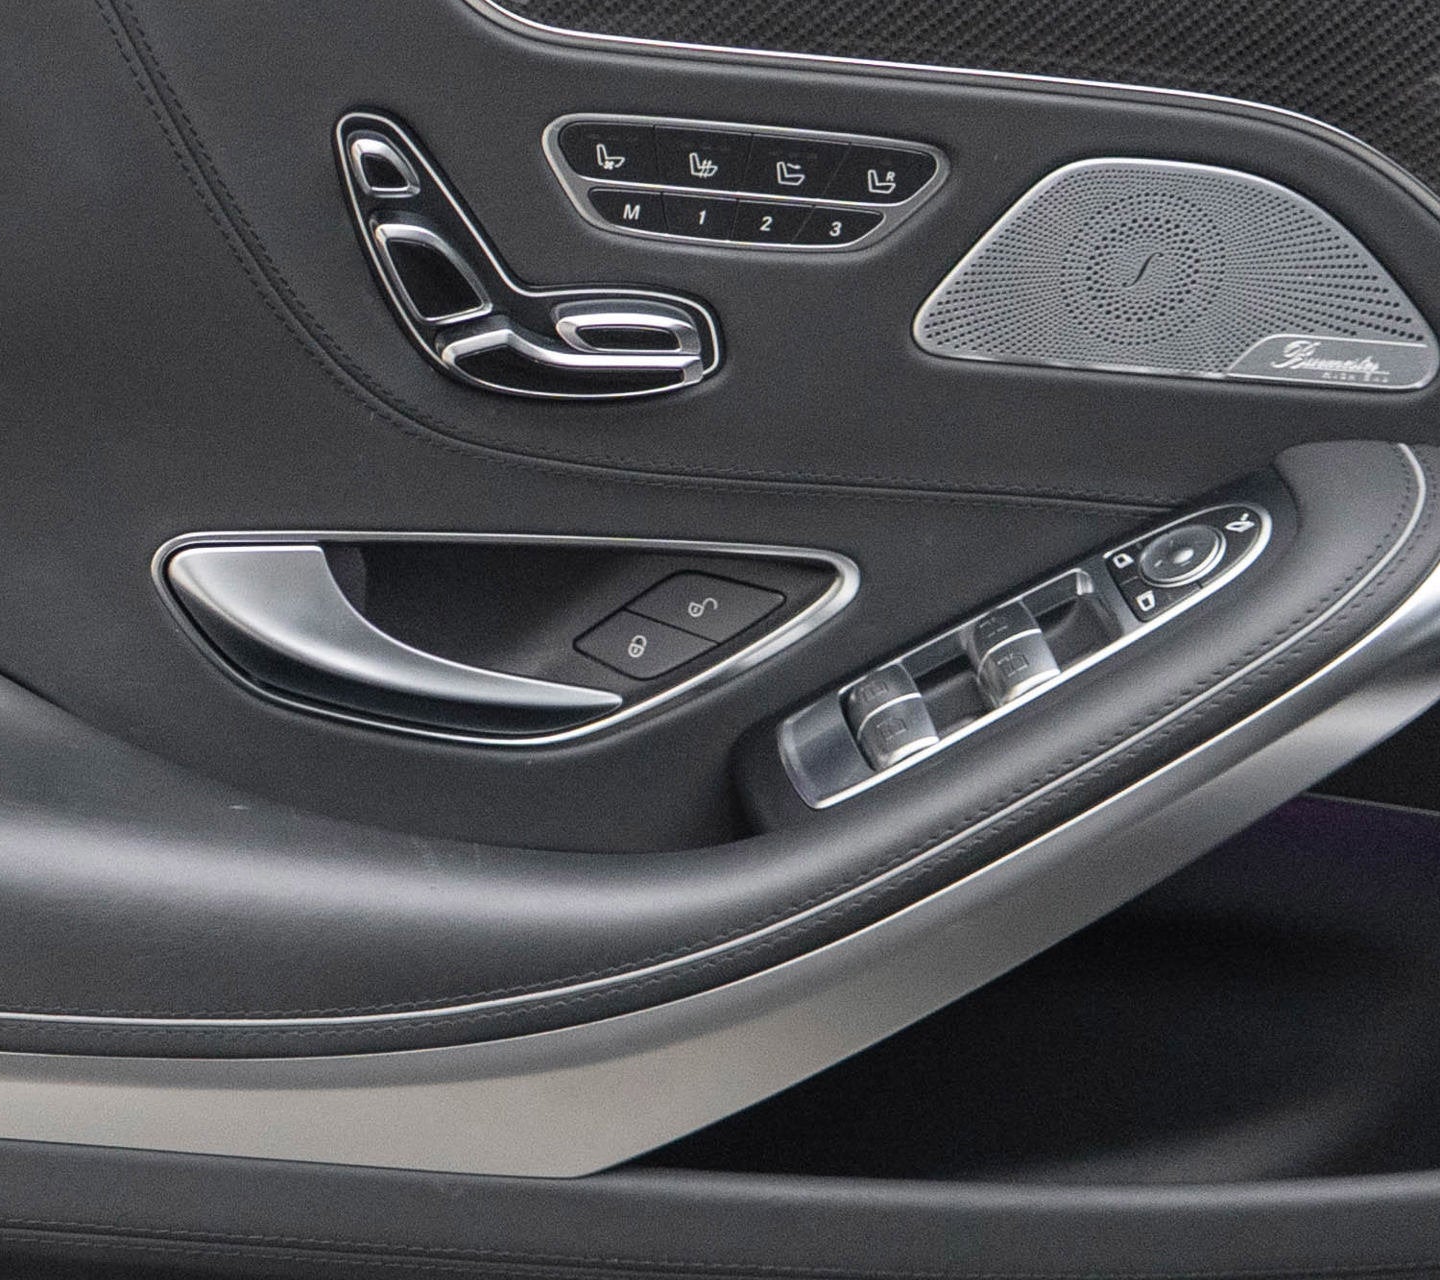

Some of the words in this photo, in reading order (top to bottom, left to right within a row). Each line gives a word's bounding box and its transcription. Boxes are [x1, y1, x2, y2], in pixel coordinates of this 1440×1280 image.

[885, 171, 896, 182] R
[623, 204, 641, 220] M
[698, 210, 707, 225] 1
[759, 216, 774, 232] 2
[829, 221, 843, 236] 3
